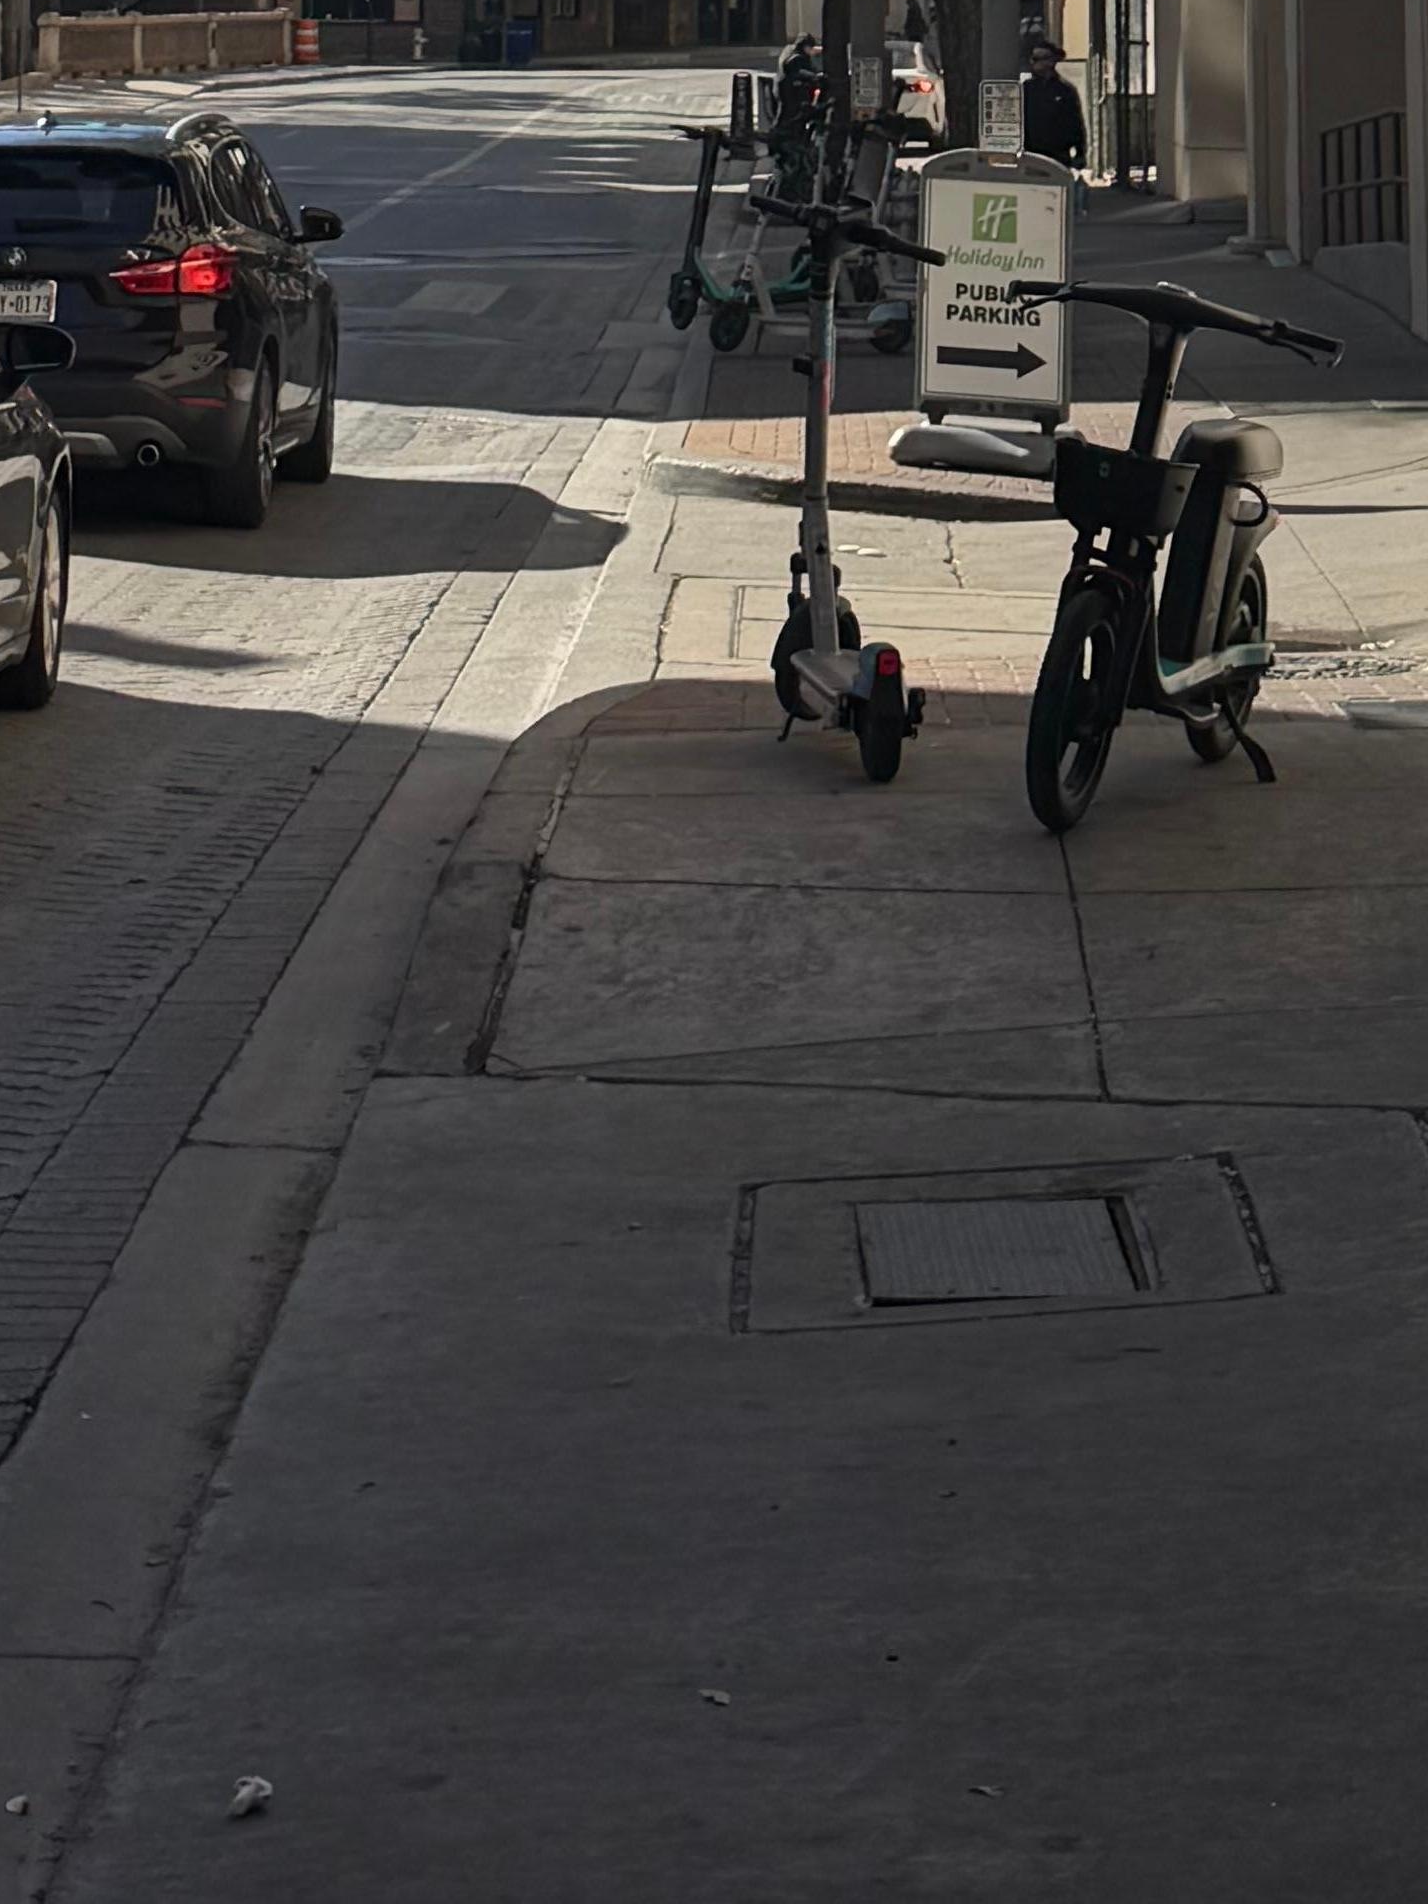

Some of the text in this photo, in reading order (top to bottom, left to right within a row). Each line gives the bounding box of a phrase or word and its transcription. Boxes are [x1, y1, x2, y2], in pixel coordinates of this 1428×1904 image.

[946, 244, 1045, 272] Holiday Inn
[946, 303, 1041, 327] PARKING
